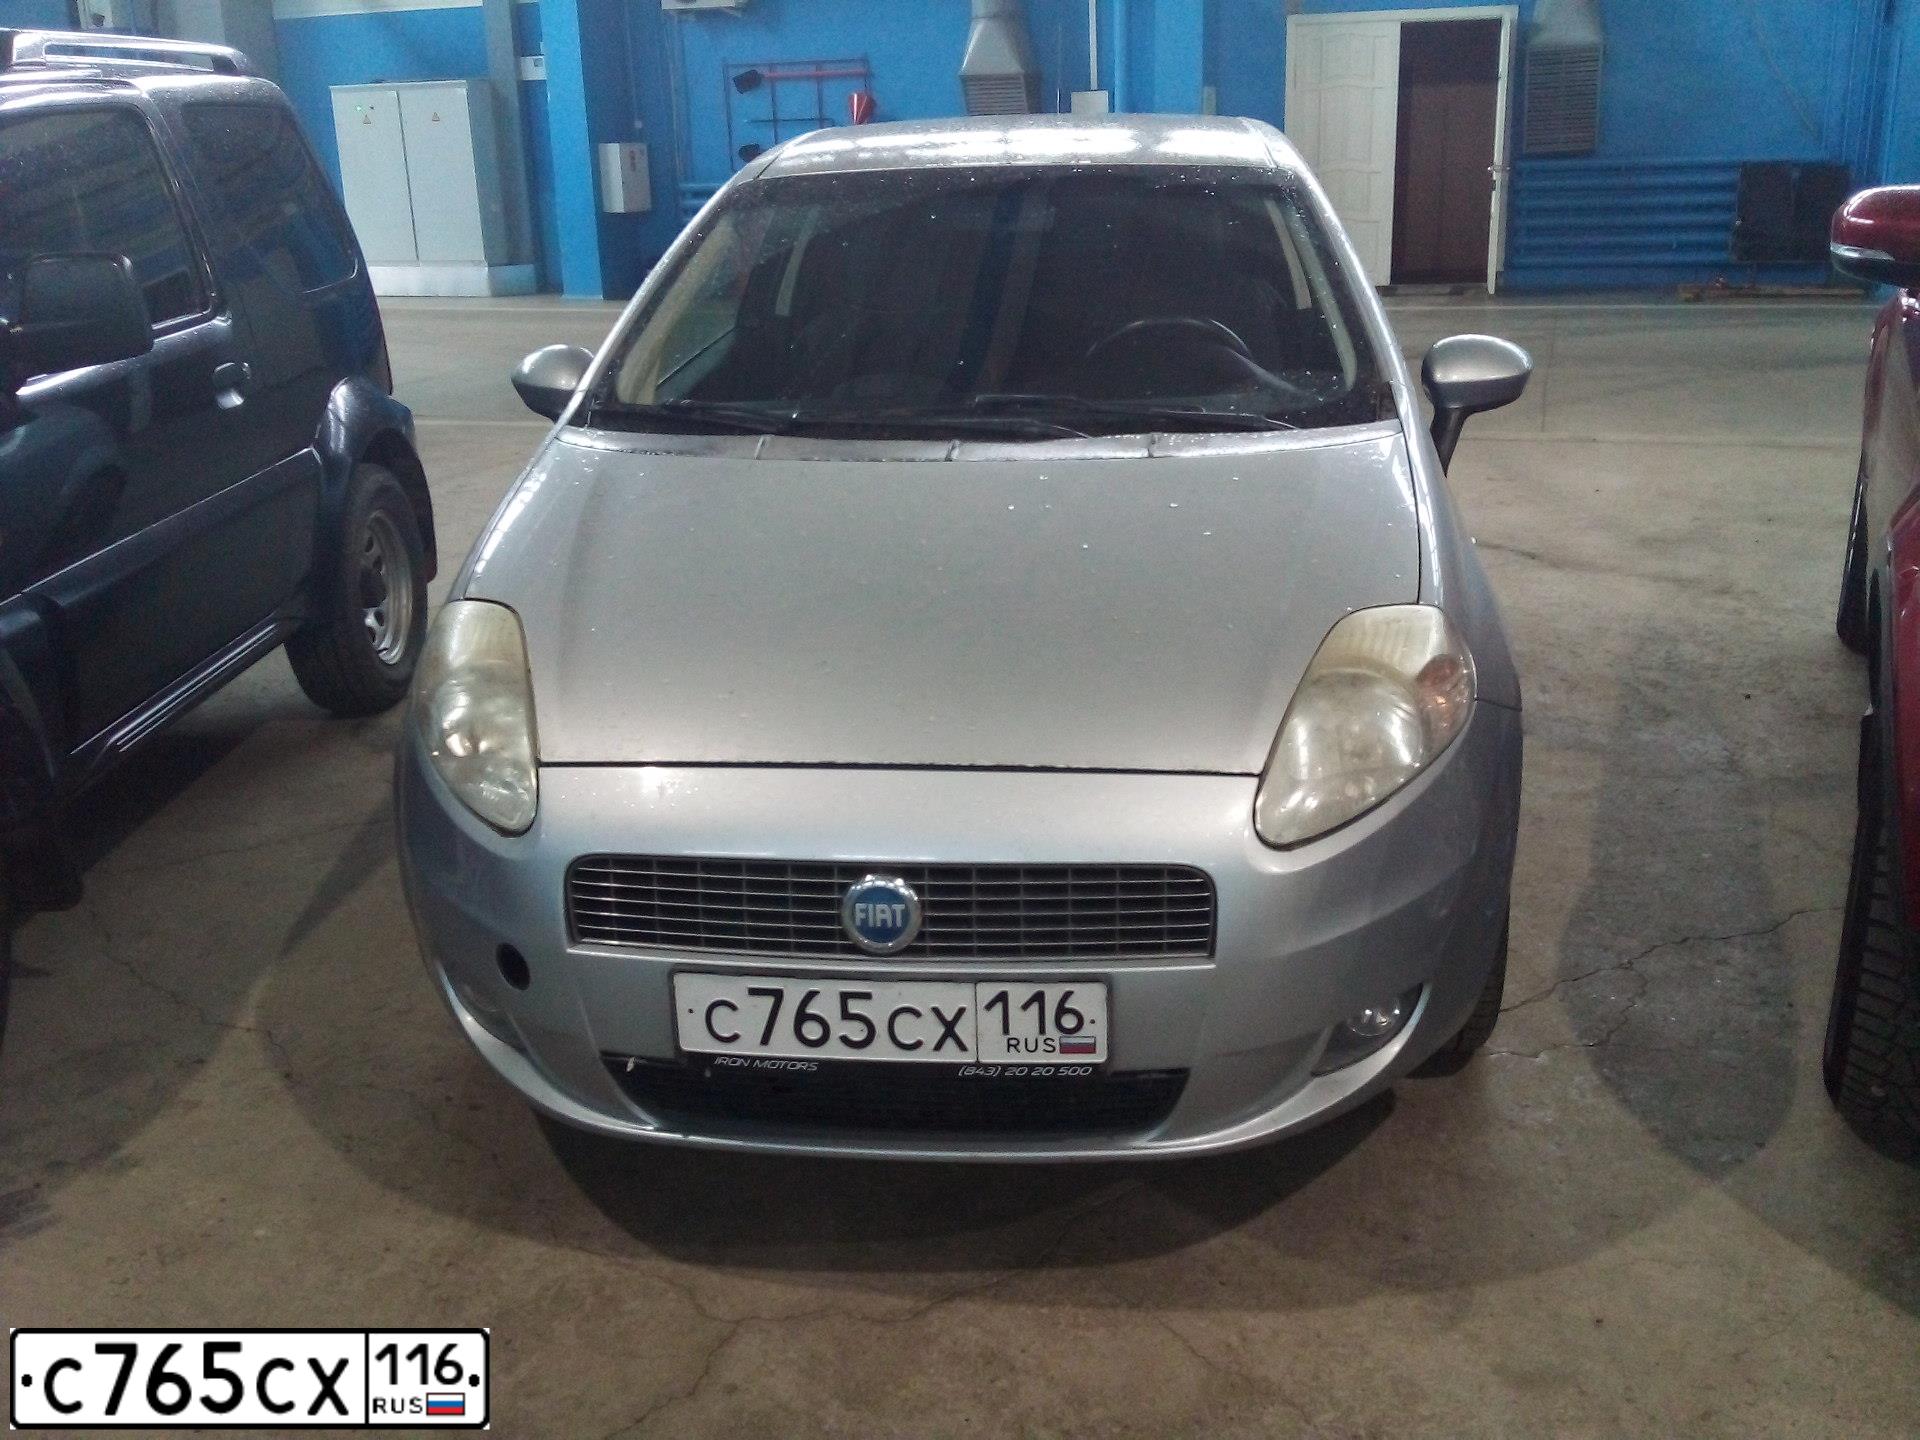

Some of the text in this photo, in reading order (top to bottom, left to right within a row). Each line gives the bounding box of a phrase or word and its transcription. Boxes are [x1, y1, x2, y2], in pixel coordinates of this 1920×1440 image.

[855, 903, 906, 928] FIAT
[984, 990, 1085, 1035] 116
[1006, 1037, 1056, 1054] RUS
[714, 1056, 819, 1071] IRON MOTORS
[958, 1065, 1092, 1077] (843) 20 20 500
